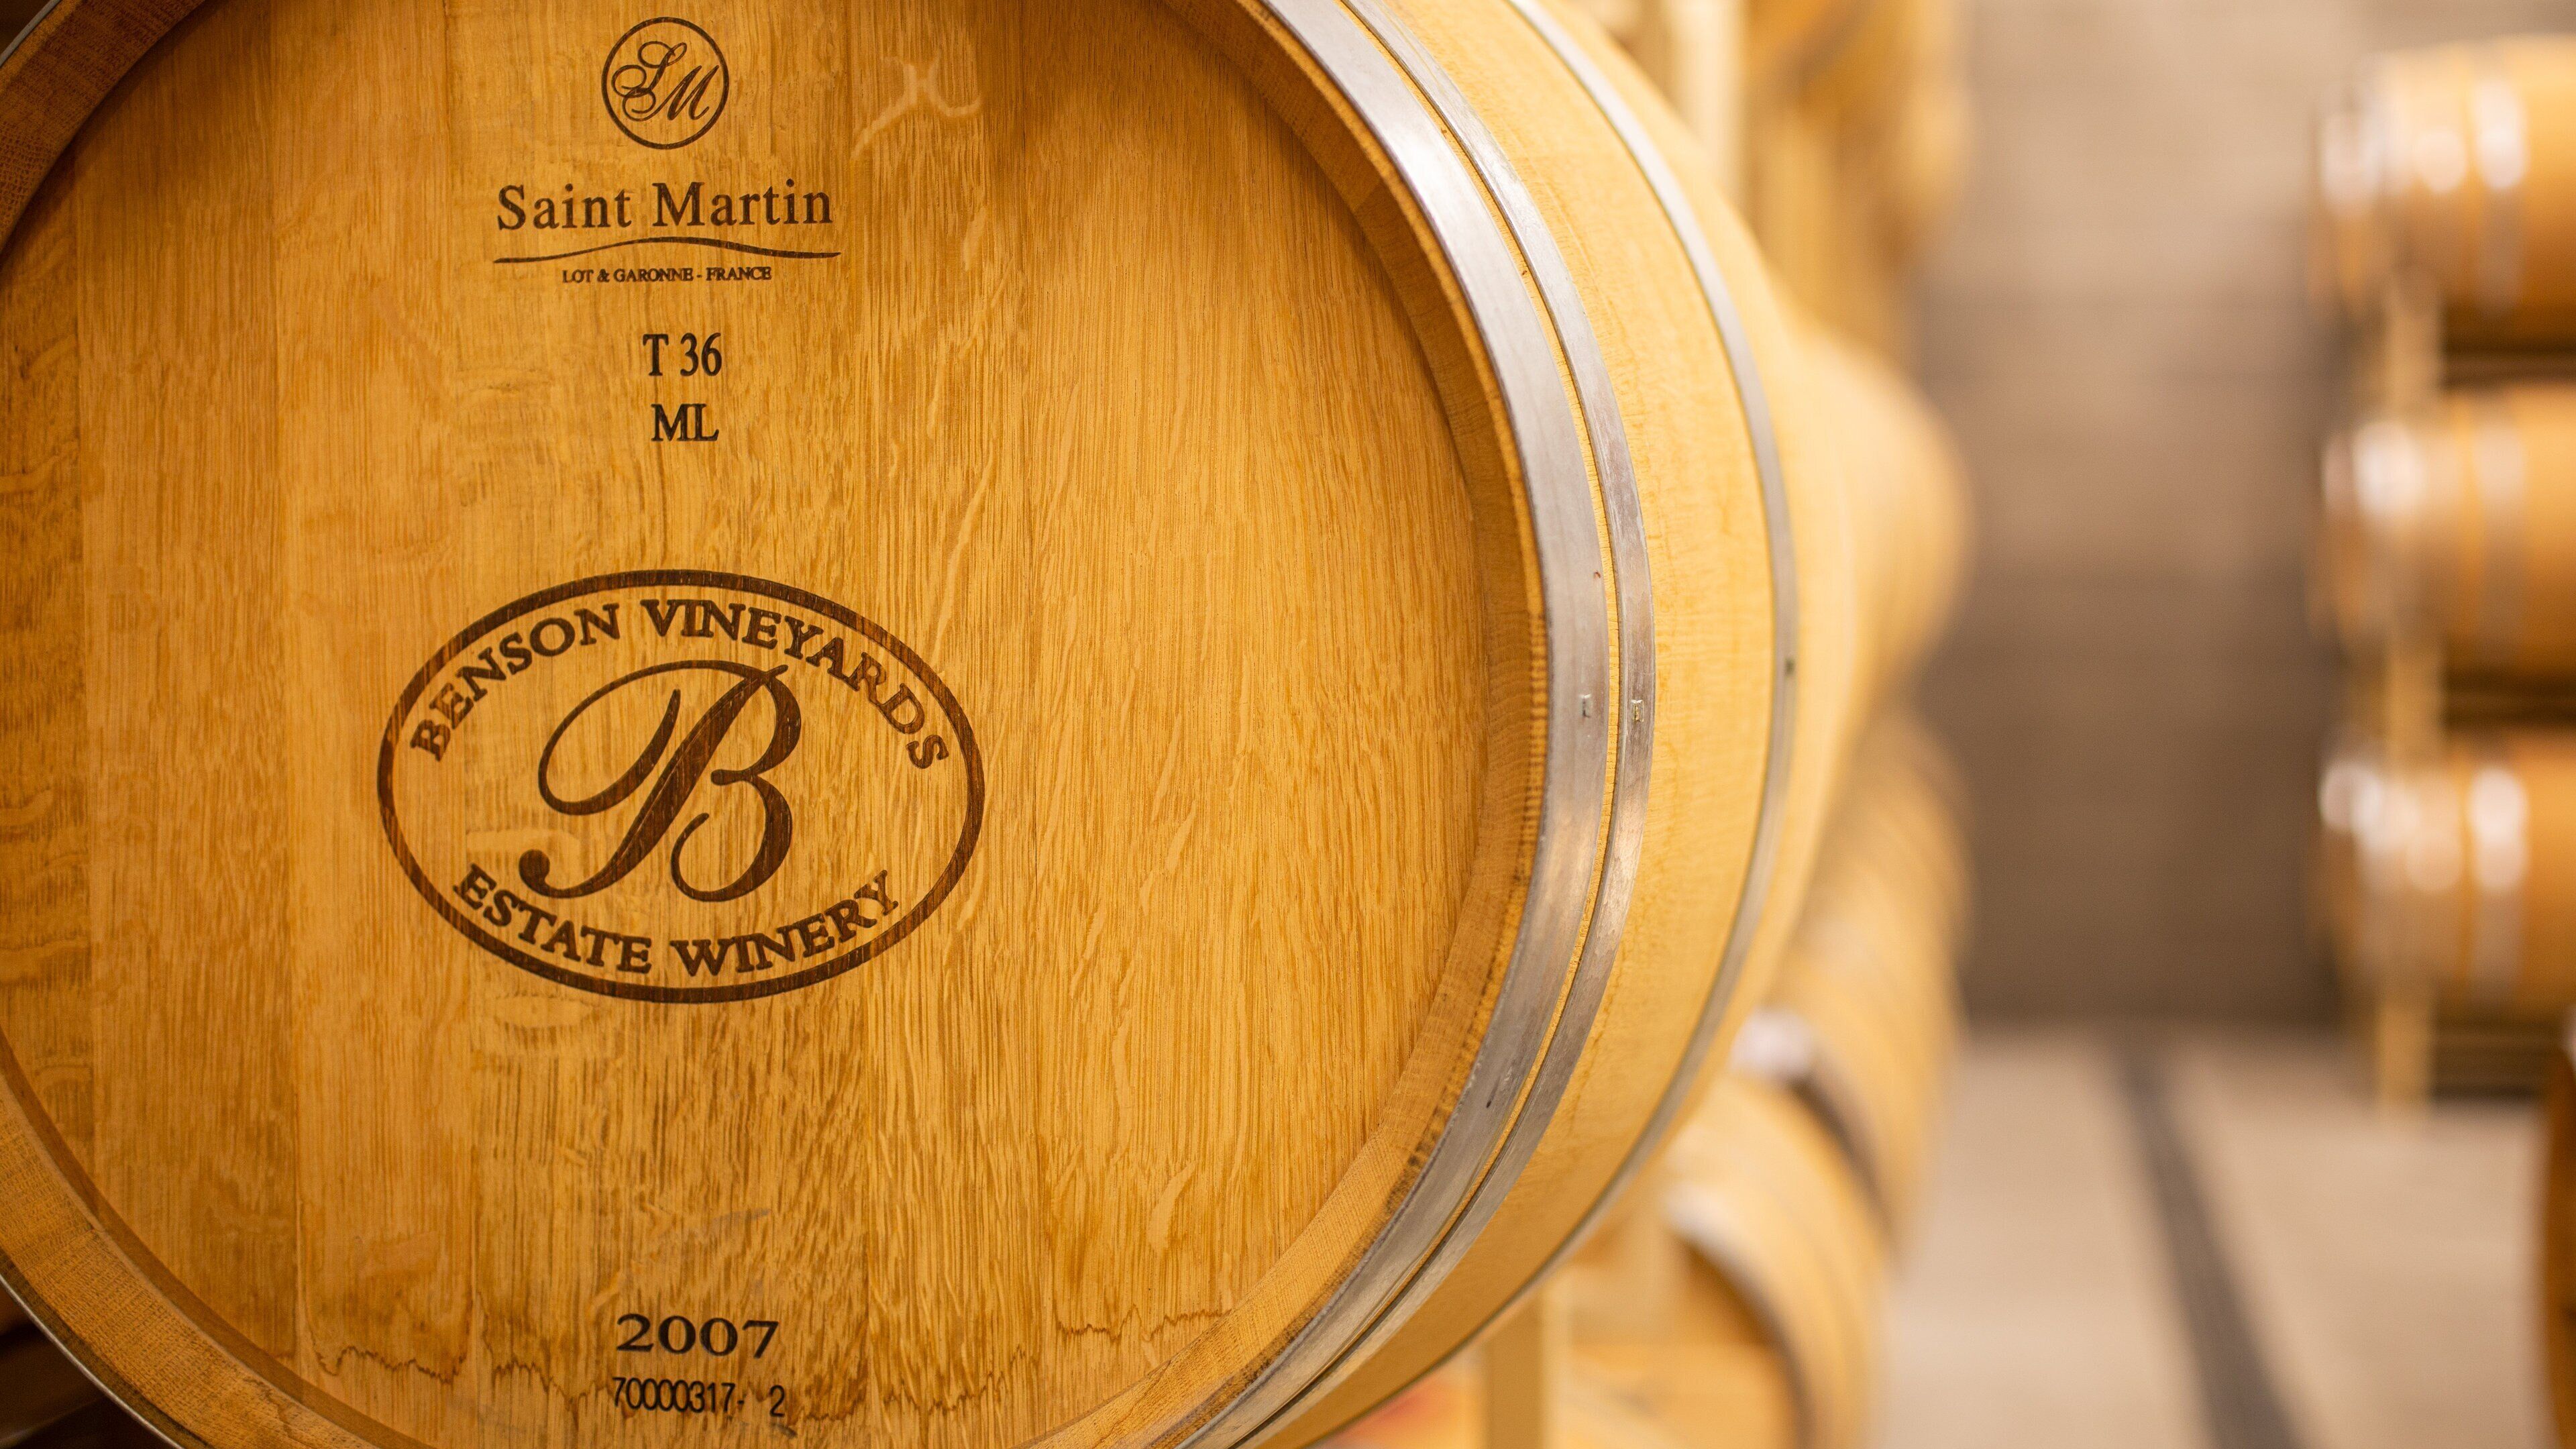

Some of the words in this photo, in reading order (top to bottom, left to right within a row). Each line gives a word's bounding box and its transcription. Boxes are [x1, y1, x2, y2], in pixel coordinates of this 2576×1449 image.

[497, 183, 632, 231] Saint
[652, 178, 833, 227] Martin
[562, 269, 594, 284] LOT
[596, 268, 610, 282] &
[613, 268, 694, 282] GARONNE
[705, 266, 772, 281] FRANCE
[642, 333, 669, 376] T
[680, 332, 722, 377] 36
[651, 402, 720, 441] ML
[409, 602, 621, 762] BENSON
[639, 598, 951, 770] VINEYARDS
[518, 659, 802, 902] B
[453, 863, 653, 975] ESTATE
[670, 868, 900, 977] WINERY
[616, 1313, 779, 1359] 2007
[769, 1385, 786, 1417] 2
